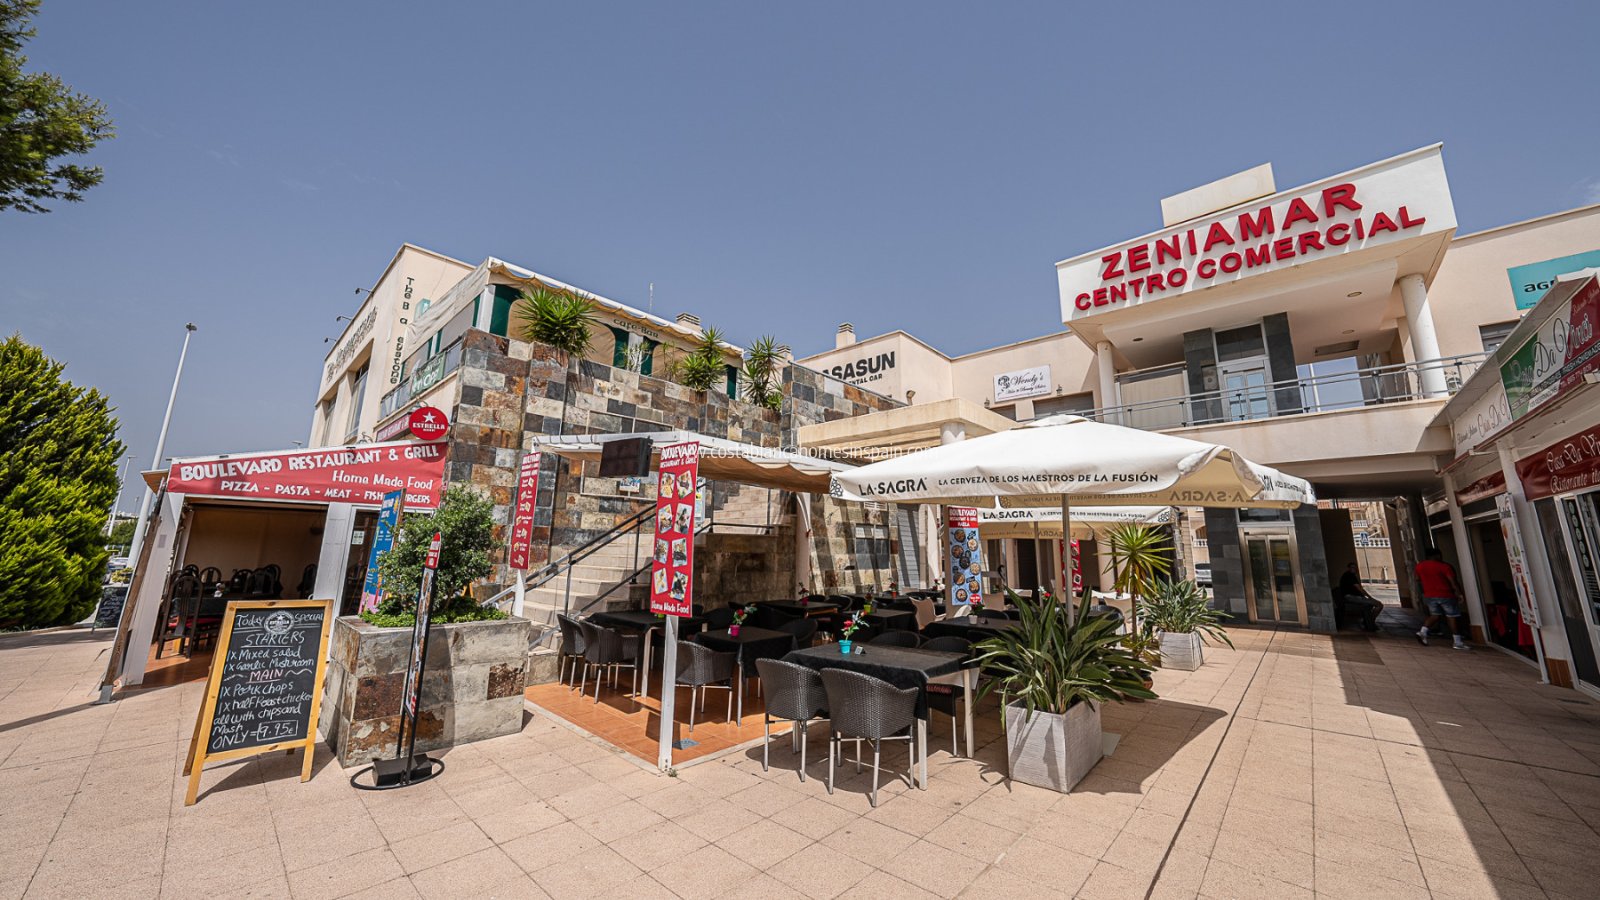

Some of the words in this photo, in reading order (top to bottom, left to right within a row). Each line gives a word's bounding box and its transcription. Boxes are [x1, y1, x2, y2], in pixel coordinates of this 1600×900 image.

[1101, 182, 1364, 282] ZENIAMAR
[1074, 267, 1188, 311] CENTRO
[1196, 205, 1427, 280] COMERCIAL
[869, 373, 883, 382] CAR
[1010, 371, 1044, 386] Wendy's
[412, 422, 446, 430] ESTRELLA
[180, 458, 283, 481] BOULEVARD
[288, 450, 382, 471] RESTAURANT
[388, 451, 397, 461] &
[404, 445, 438, 460] GRILL
[332, 470, 369, 485] Home
[372, 474, 404, 489] Made
[407, 477, 433, 492] Food
[951, 477, 987, 486] CERVEZA
[1002, 475, 1020, 483] LOS
[1022, 474, 1075, 483] MAESTROS
[1078, 474, 1091, 482] DE
[1094, 474, 1109, 482] LA
[1112, 471, 1159, 483] FUSIÓN
[221, 481, 259, 493] PIZZA
[275, 484, 311, 496] PASTA
[324, 488, 351, 499] MEAT
[364, 491, 384, 501] FISH
[246, 631, 305, 646] STARTERS
[240, 651, 269, 662] Mixed
[249, 668, 283, 681] MAIN
